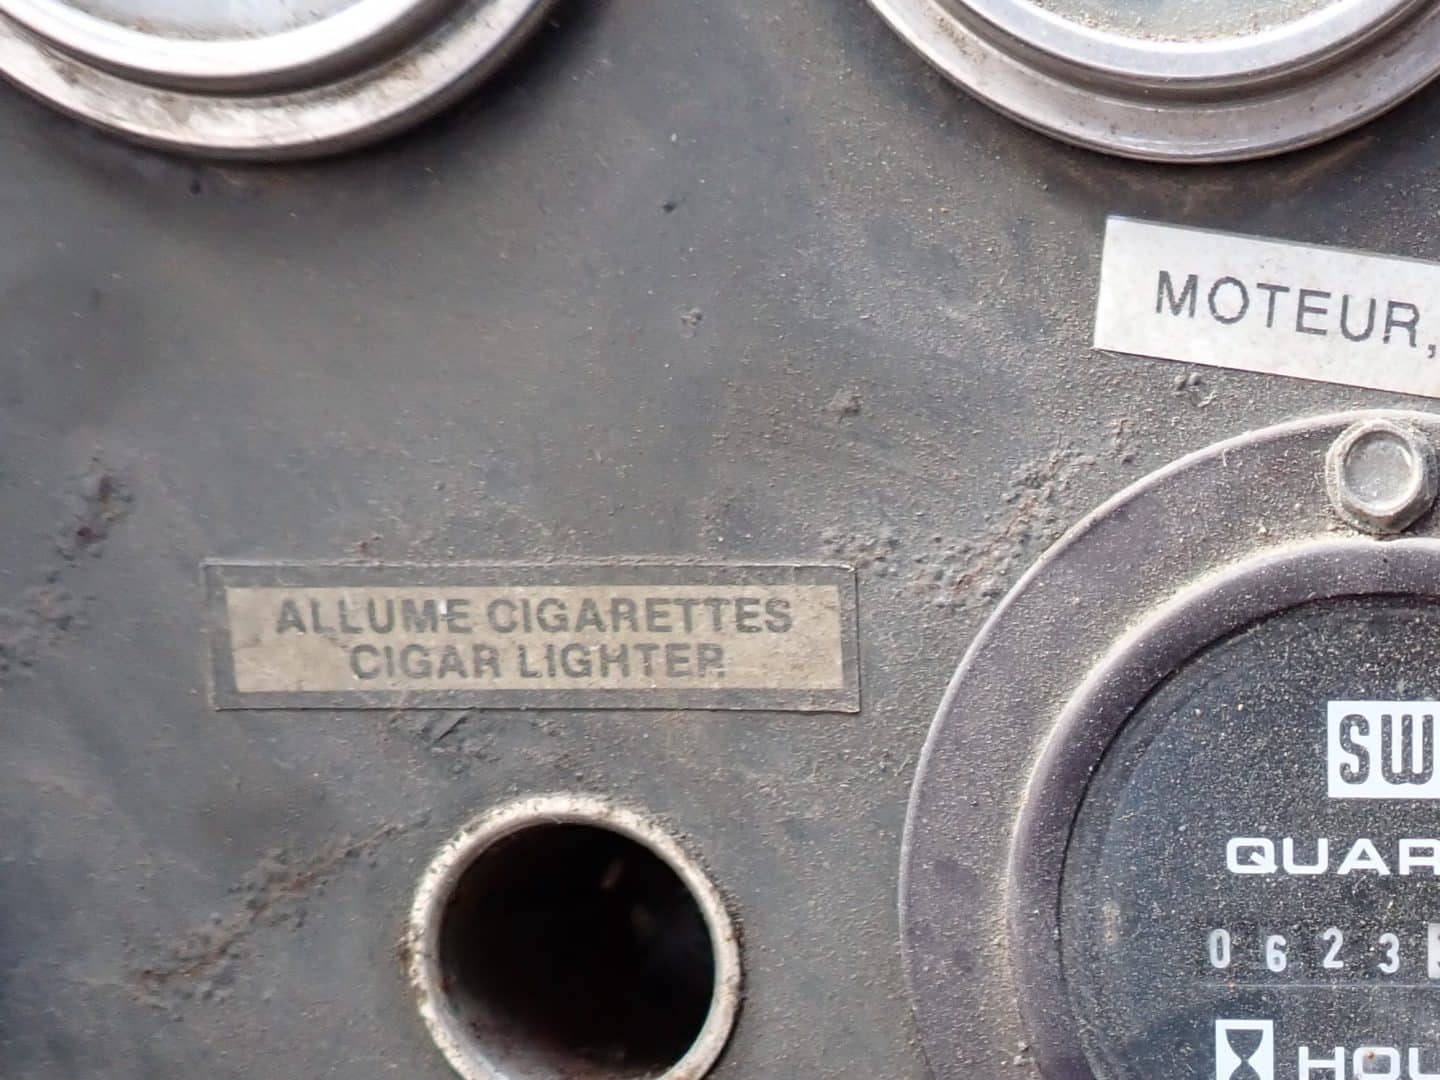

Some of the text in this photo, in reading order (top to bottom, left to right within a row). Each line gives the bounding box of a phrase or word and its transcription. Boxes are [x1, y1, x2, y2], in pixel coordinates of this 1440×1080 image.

[275, 596, 793, 634] ALLUME CIGARETTES
[349, 643, 727, 680] CIGAR LIGHTER
[1338, 713, 1435, 786] SW
